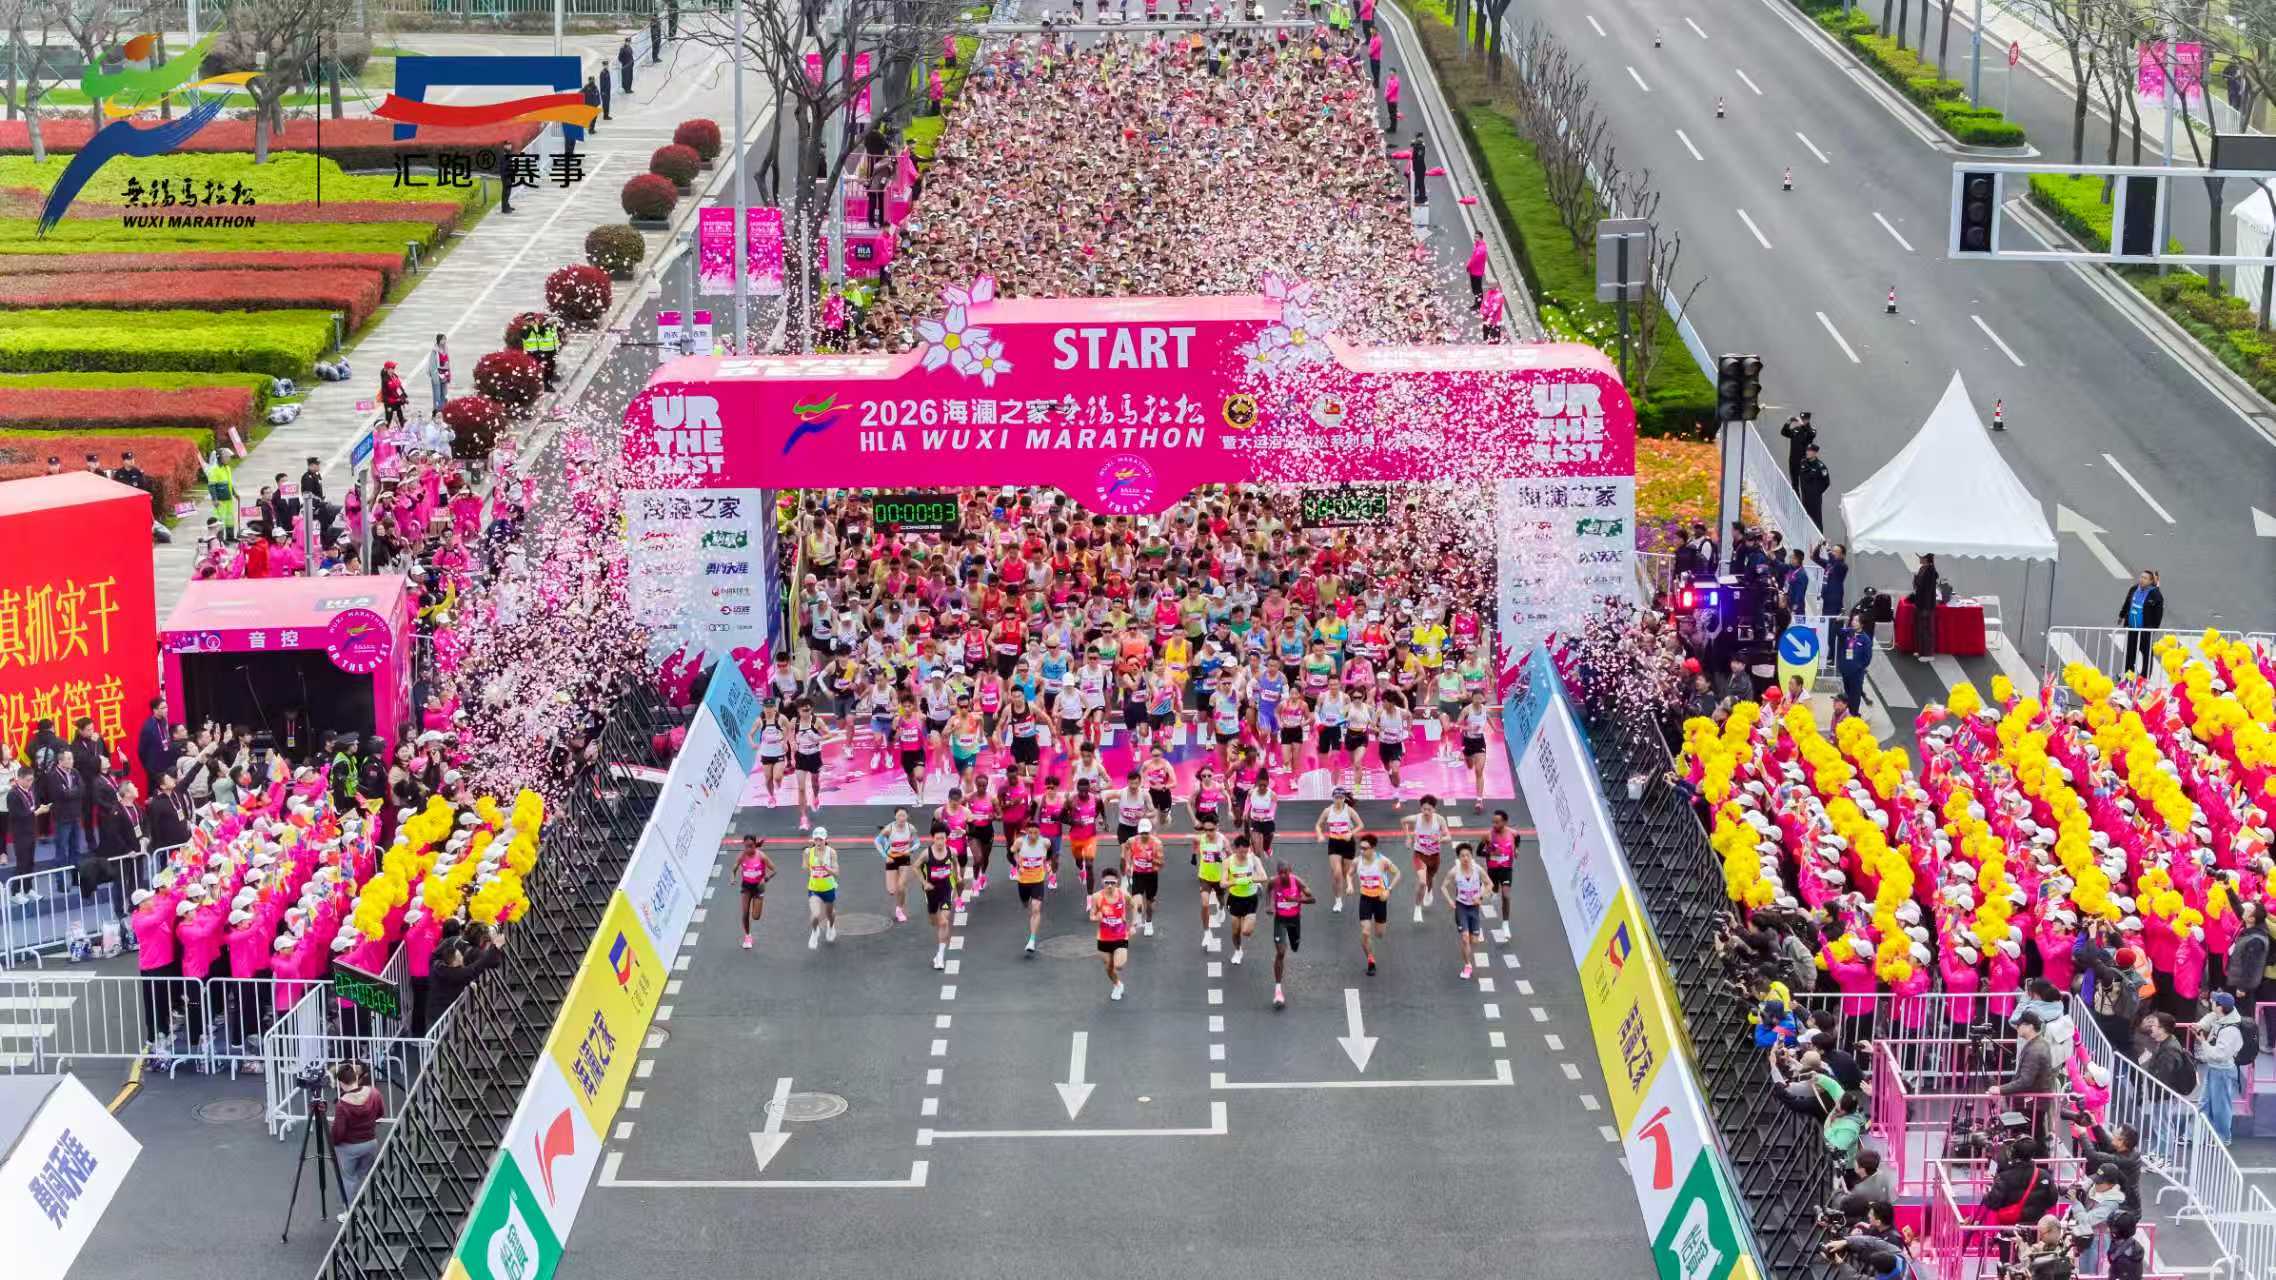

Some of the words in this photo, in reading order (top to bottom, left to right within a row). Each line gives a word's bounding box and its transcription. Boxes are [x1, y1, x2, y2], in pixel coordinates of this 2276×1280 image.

[1053, 327, 1197, 371] START
[651, 395, 723, 429] UR
[1531, 383, 1604, 418] UR
[653, 431, 724, 453] THE
[860, 431, 907, 453] HLA
[922, 430, 1009, 451] WUXI
[1025, 427, 1206, 450] MARATHON
[1533, 418, 1604, 441] THE
[875, 503, 957, 523] 00:00:03
[0, 575, 120, 668] 真抓实干
[249, 631, 299, 649] 音控
[342, 659, 364, 672] THE
[571, 1008, 616, 1106] 海澜之家
[1617, 996, 1653, 1096] 海澜之家
[28, 1127, 98, 1231] 勇闯天涯
